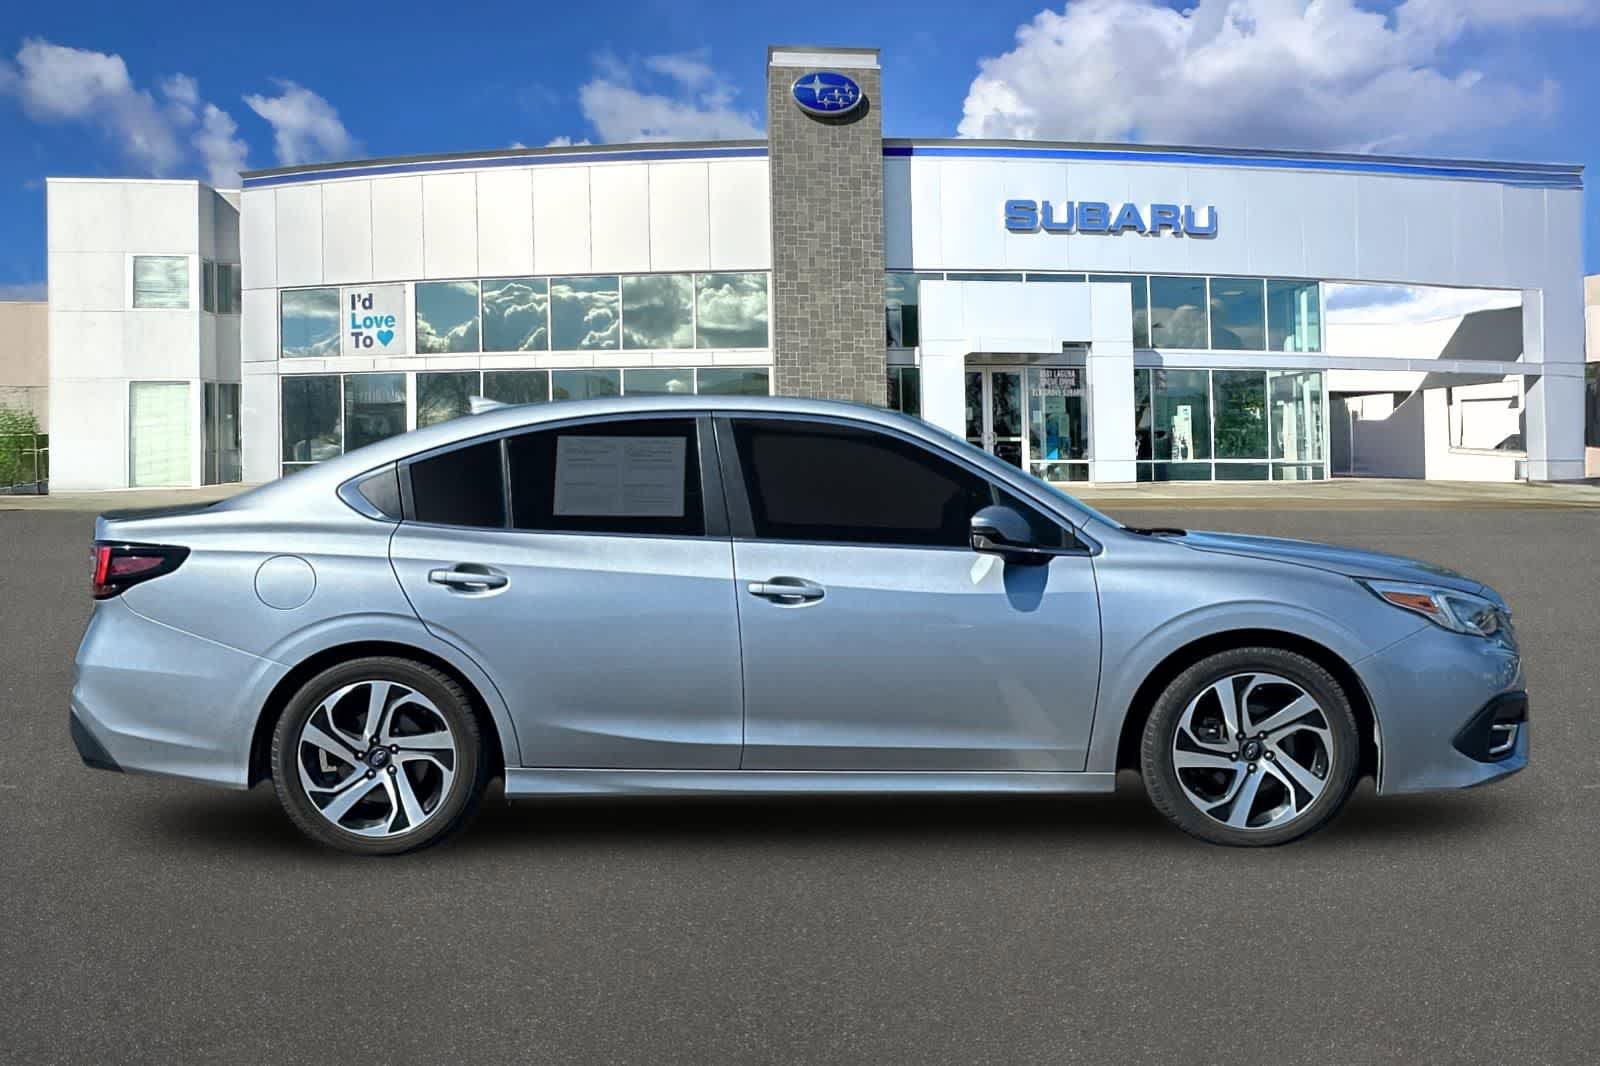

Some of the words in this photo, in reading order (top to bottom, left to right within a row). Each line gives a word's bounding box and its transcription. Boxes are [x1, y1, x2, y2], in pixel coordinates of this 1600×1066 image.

[1005, 199, 1217, 237] SUBARU
[351, 312, 396, 329] Love
[351, 331, 373, 348] To
